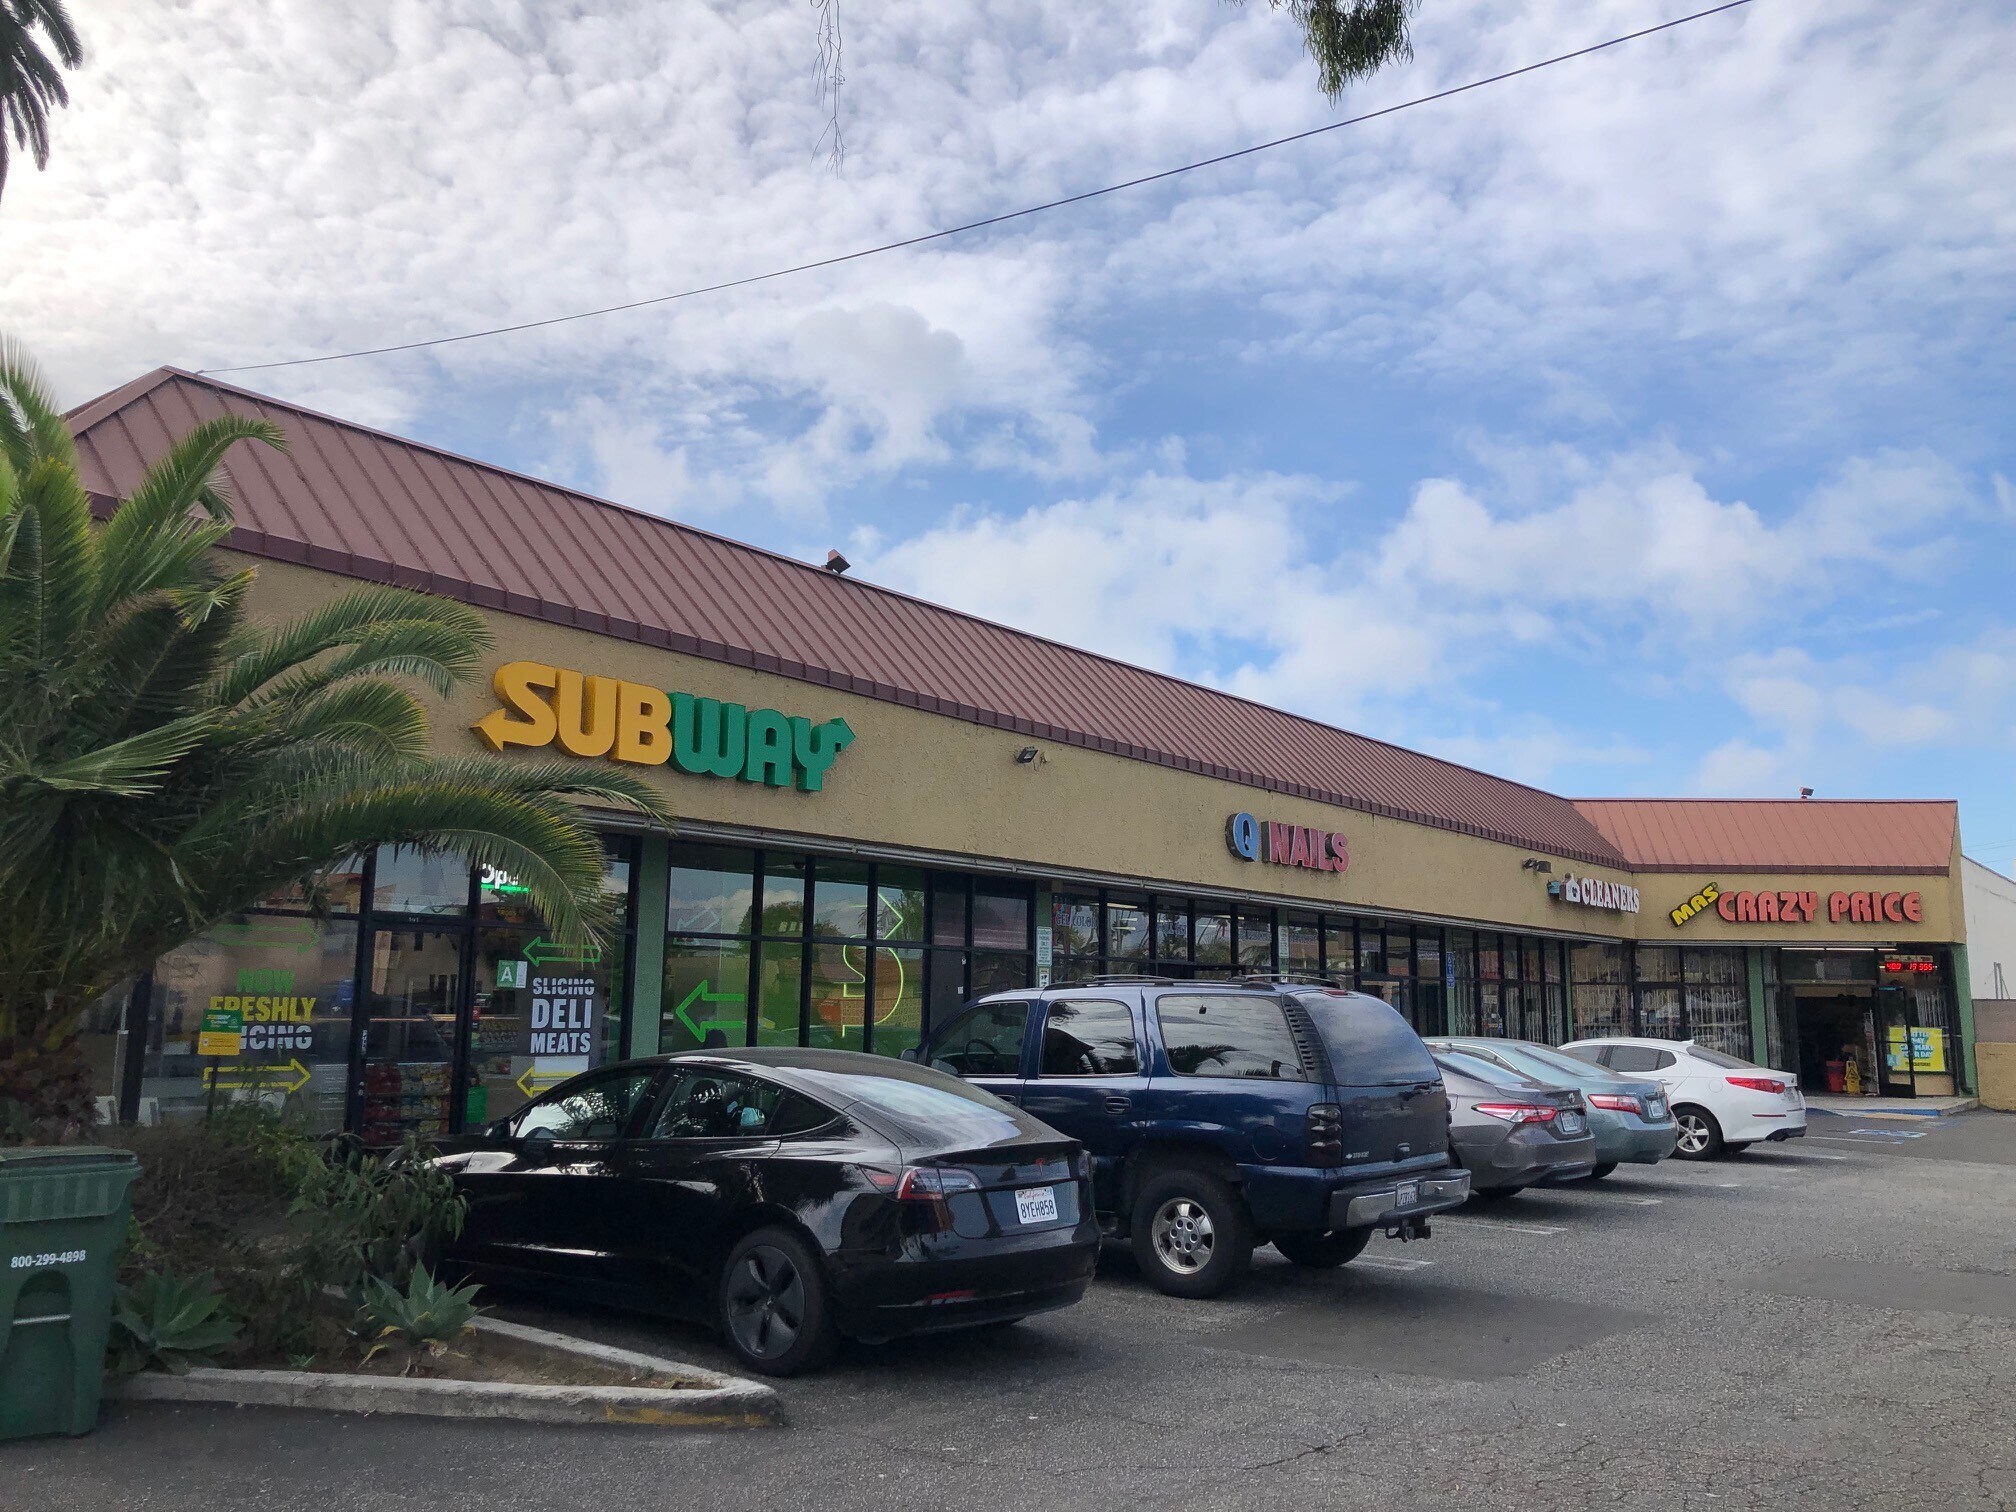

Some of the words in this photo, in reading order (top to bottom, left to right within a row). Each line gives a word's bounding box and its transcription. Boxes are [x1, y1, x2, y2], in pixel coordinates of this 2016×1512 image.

[470, 661, 856, 791] SUBWAY
[1225, 812, 1259, 862] Q
[1261, 821, 1349, 873] NAILS
[1579, 877, 1639, 914] CLEANERS
[1717, 891, 1817, 922] CRAZY
[1829, 891, 1922, 922] PRICE
[236, 968, 296, 994] NOW
[500, 966, 513, 982] A
[532, 977, 595, 996] SLICING
[531, 998, 592, 1029] DELI
[530, 1032, 591, 1053] MEATS
[1020, 1200, 1054, 1218] 8YEH858
[11, 1249, 86, 1268] 800-299-4898
